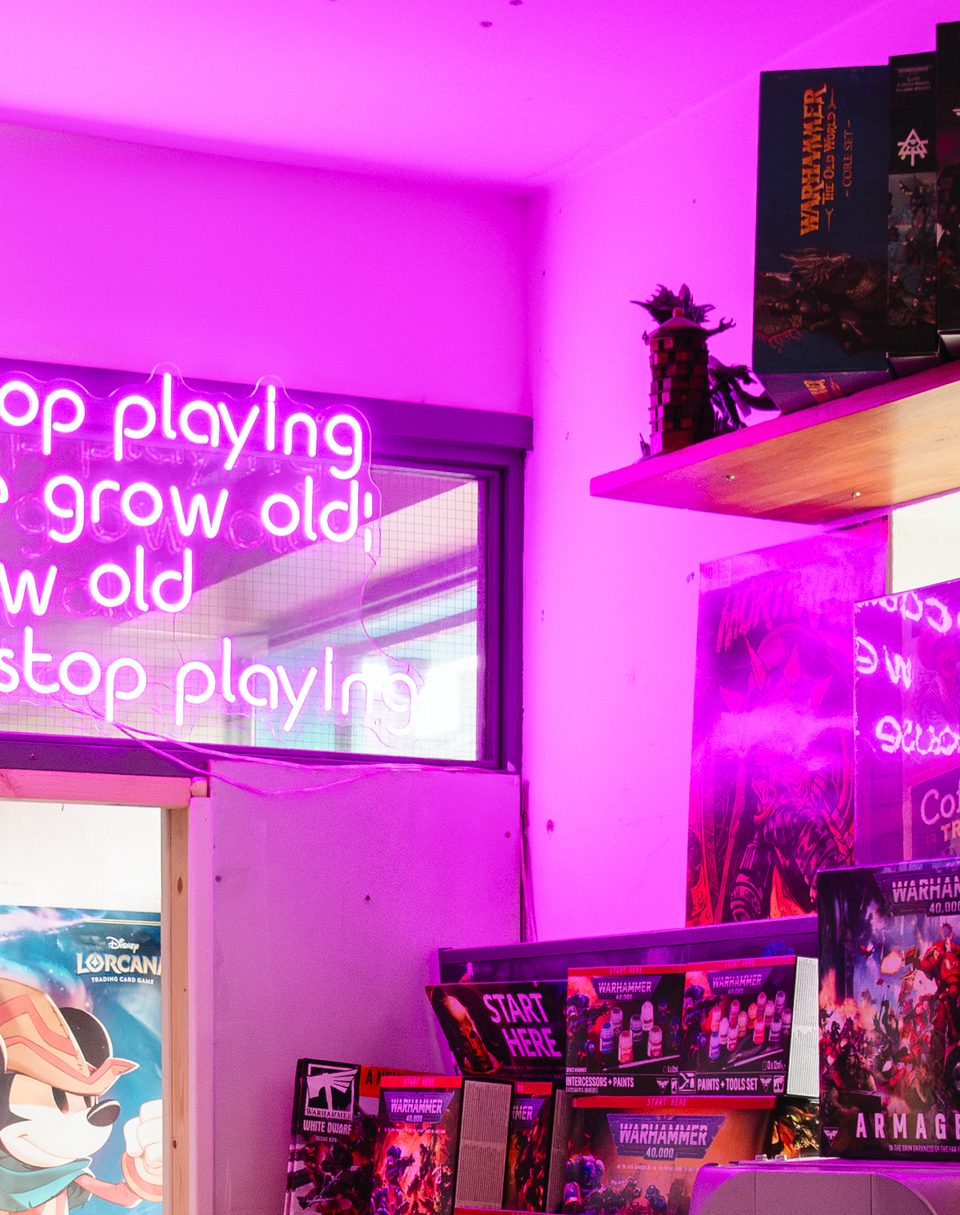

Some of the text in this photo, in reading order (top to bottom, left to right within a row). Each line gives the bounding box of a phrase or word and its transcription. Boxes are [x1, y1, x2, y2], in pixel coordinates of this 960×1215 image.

[800, 82, 827, 236] WARHAMMER
[114, 371, 363, 480] playing
[44, 475, 229, 544] grow
[88, 545, 193, 613] old
[175, 636, 420, 737] playing
[920, 780, 960, 826] Co
[106, 935, 140, 954] Disney
[91, 976, 154, 985] TRADING CARD GAME
[598, 981, 652, 994] WARHAMMER
[712, 974, 763, 988] WARHAMMER
[483, 993, 549, 1024] START
[502, 1028, 563, 1058] HERE
[566, 1076, 608, 1088] INTERCESSORS
[613, 1077, 634, 1088] PAINTS
[697, 1078, 720, 1091] PAINTS
[725, 1078, 746, 1090] TOOLS
[746, 1078, 758, 1090] SET
[391, 1098, 443, 1114] WARHAMMER
[303, 1119, 352, 1135] WHITE DWARF
[619, 1123, 708, 1146] WARHAMMER
[646, 1147, 674, 1159] 40,000
